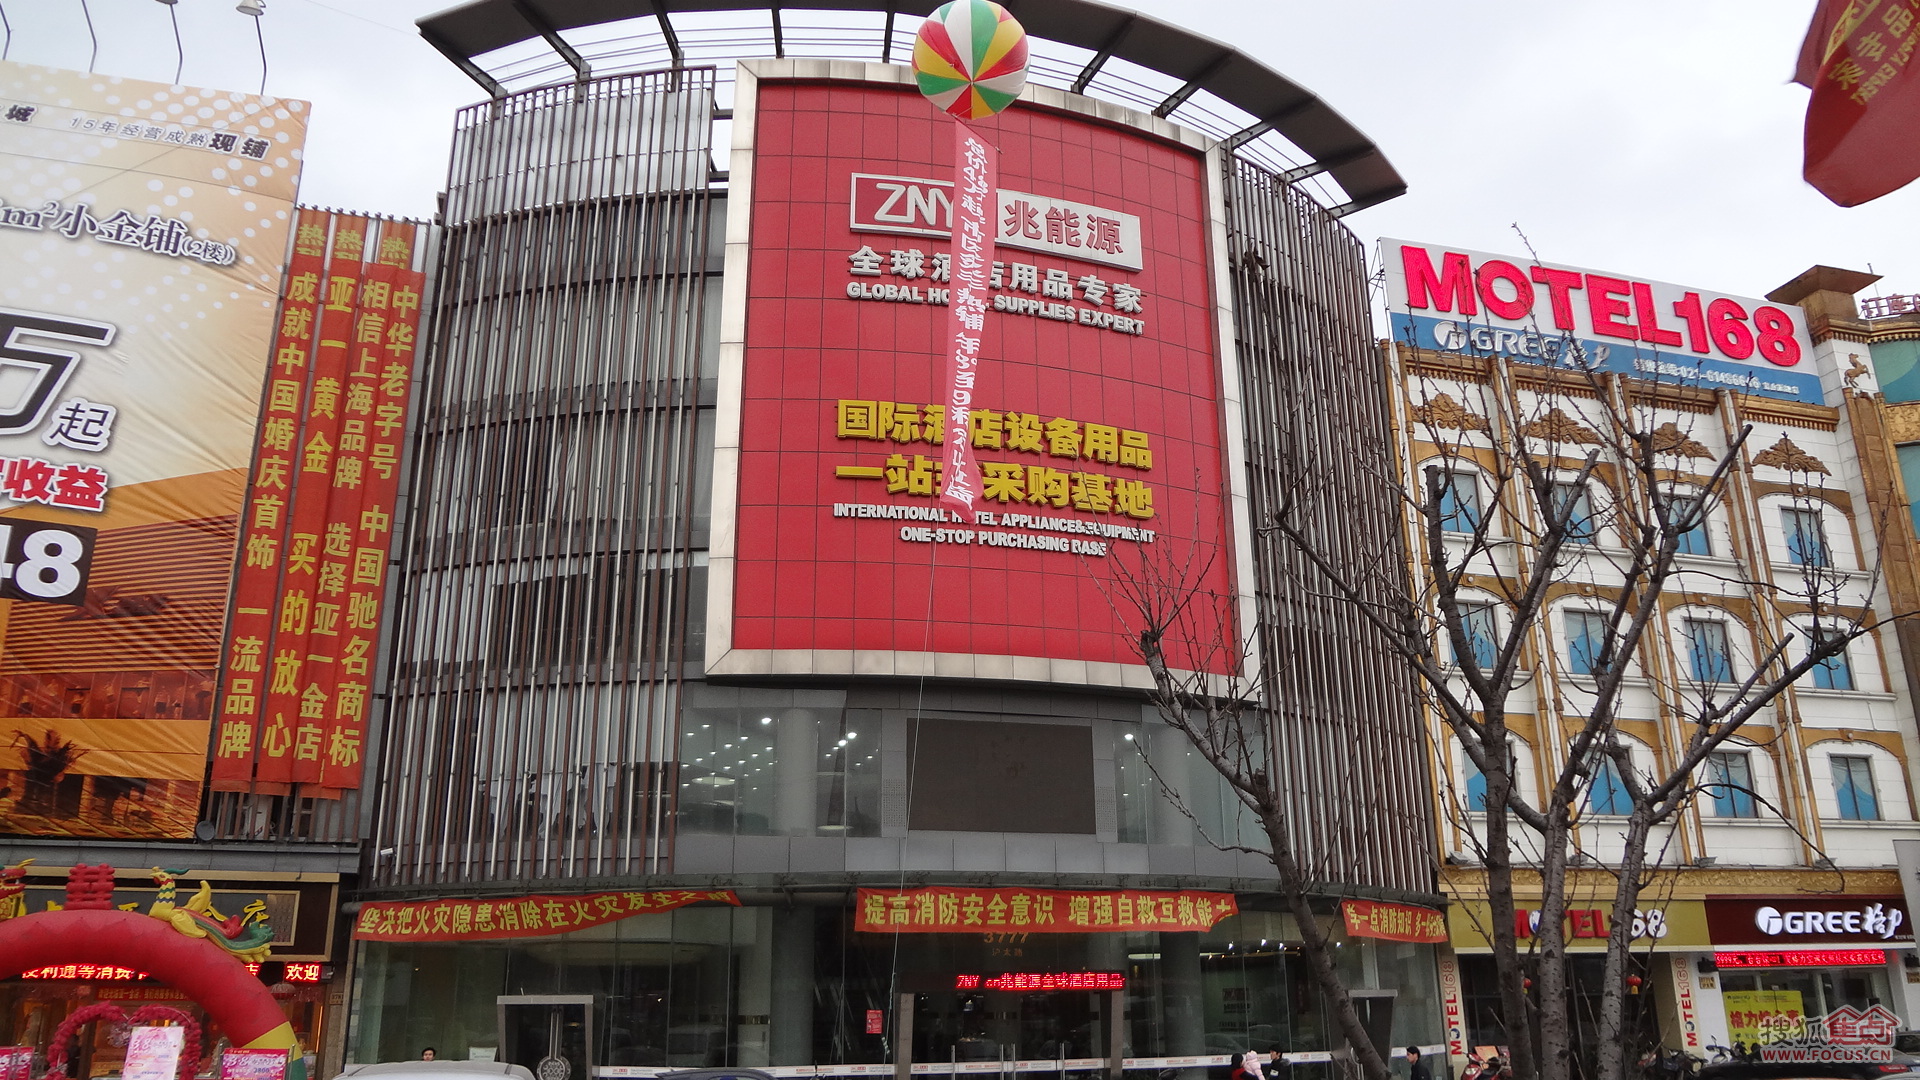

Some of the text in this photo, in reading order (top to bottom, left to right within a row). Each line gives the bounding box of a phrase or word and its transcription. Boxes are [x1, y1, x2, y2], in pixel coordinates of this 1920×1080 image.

[381, 237, 410, 270] 热
[1004, 199, 1124, 255] 兆能源
[847, 281, 923, 303] GLOBAL
[993, 294, 1076, 322] SUPPLIES
[1078, 307, 1145, 337] EXPERT
[1400, 244, 1802, 368] MOTEL168
[0, 459, 105, 509] 收益
[836, 454, 1154, 519] 一站采购基地
[218, 271, 319, 759] 成就中国婚庆首饰 一流品牌
[262, 275, 357, 758] 亚一黄金 买的放心
[295, 279, 391, 761] 相信上海品牌 选择亚一金店
[329, 286, 419, 768] 中华老字号 中国驰名商标
[833, 503, 948, 523] INTERNATIONAL
[951, 510, 998, 527] HTEL
[900, 526, 975, 545] ONE-STOP
[978, 531, 1070, 554] PURCHASING
[865, 893, 1056, 926] 提高消防安全意识
[1784, 911, 1861, 934] GREE
[286, 964, 320, 981] 欢迎
[1442, 960, 1462, 1055] MOTEL168
[1675, 957, 1698, 1047] MOTEL168
